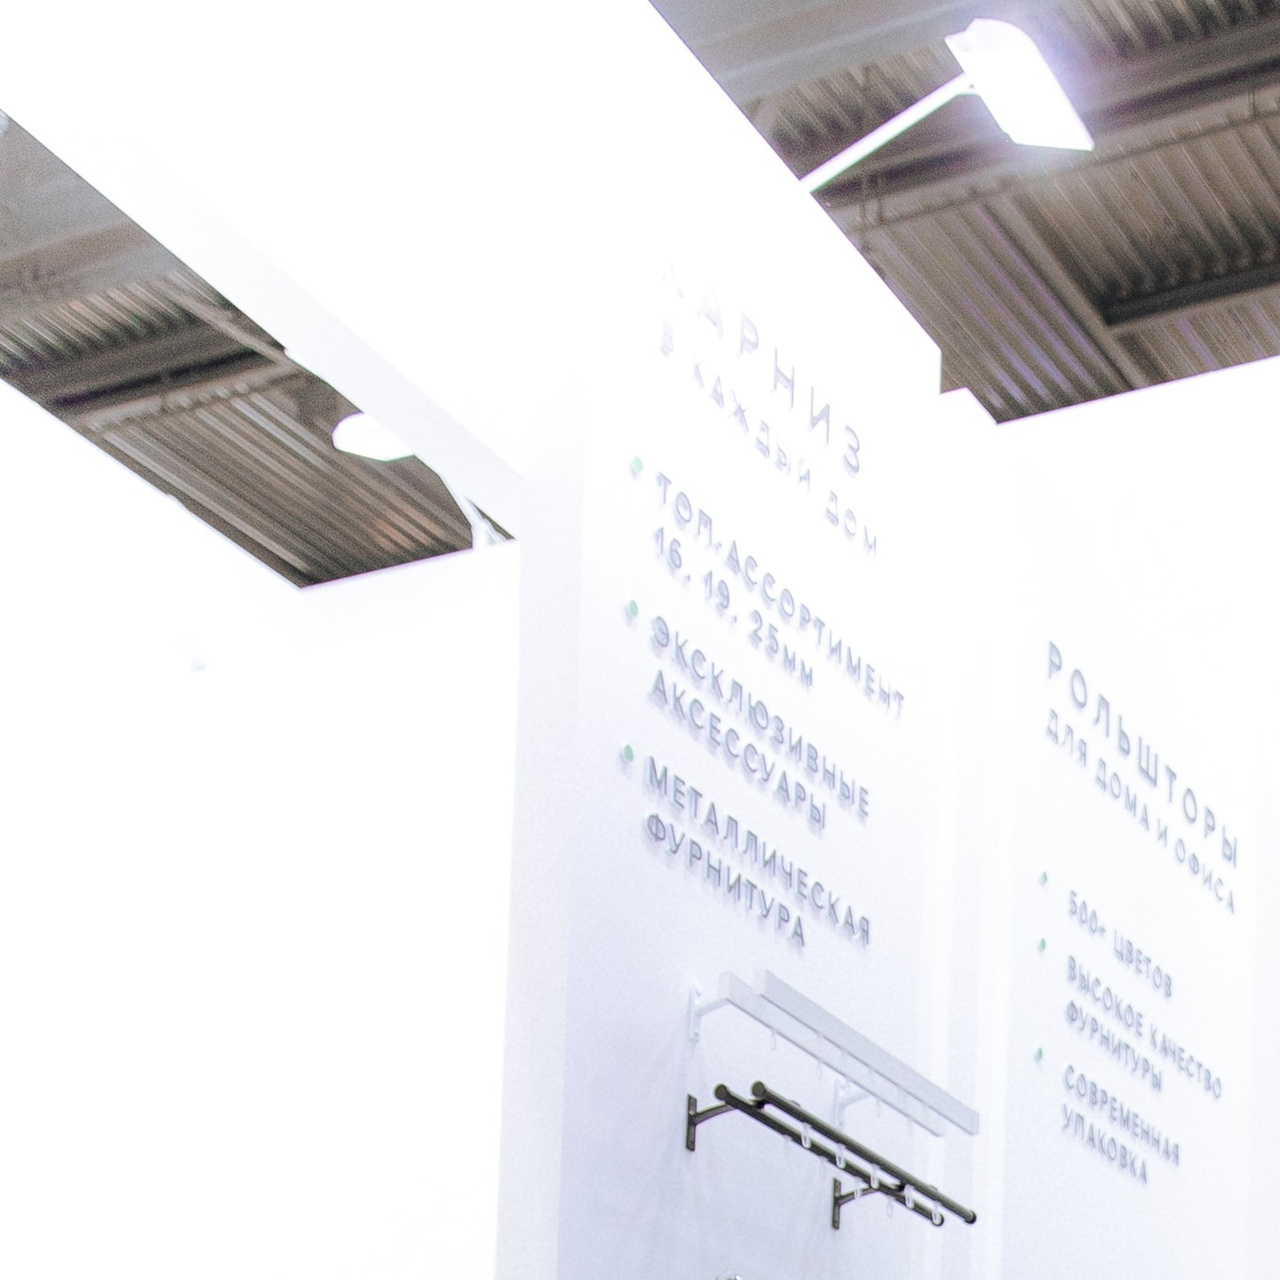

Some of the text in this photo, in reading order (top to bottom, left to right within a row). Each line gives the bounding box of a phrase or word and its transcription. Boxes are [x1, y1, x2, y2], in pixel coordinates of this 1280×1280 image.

[655, 472, 905, 716] ТОП-АССОРТИМЕНТ
[650, 615, 870, 819] ЭКСКЛЮЗИВНЫЕ
[650, 670, 826, 830] АКСЕССУАРЫ
[1048, 641, 1238, 869] РОЛЬШТОРЫ
[645, 812, 806, 948] ФУРНИТУРА
[648, 756, 871, 946] МЕТАЛЛИЧЕСКАЯ
[1046, 708, 1236, 915] ДЛЯ ДОМА И ОФИСА
[1068, 891, 1173, 1001] 500+ ЦВЕТОВ
[1065, 999, 1163, 1092] ФУРНИТУРЫ
[1067, 955, 1223, 1101] ВЫСОКОЕ КАЧЕСТВО
[1061, 1104, 1148, 1185] УПАКОВКА
[1064, 1065, 1181, 1167] СОВРЕМЕННАЯ
